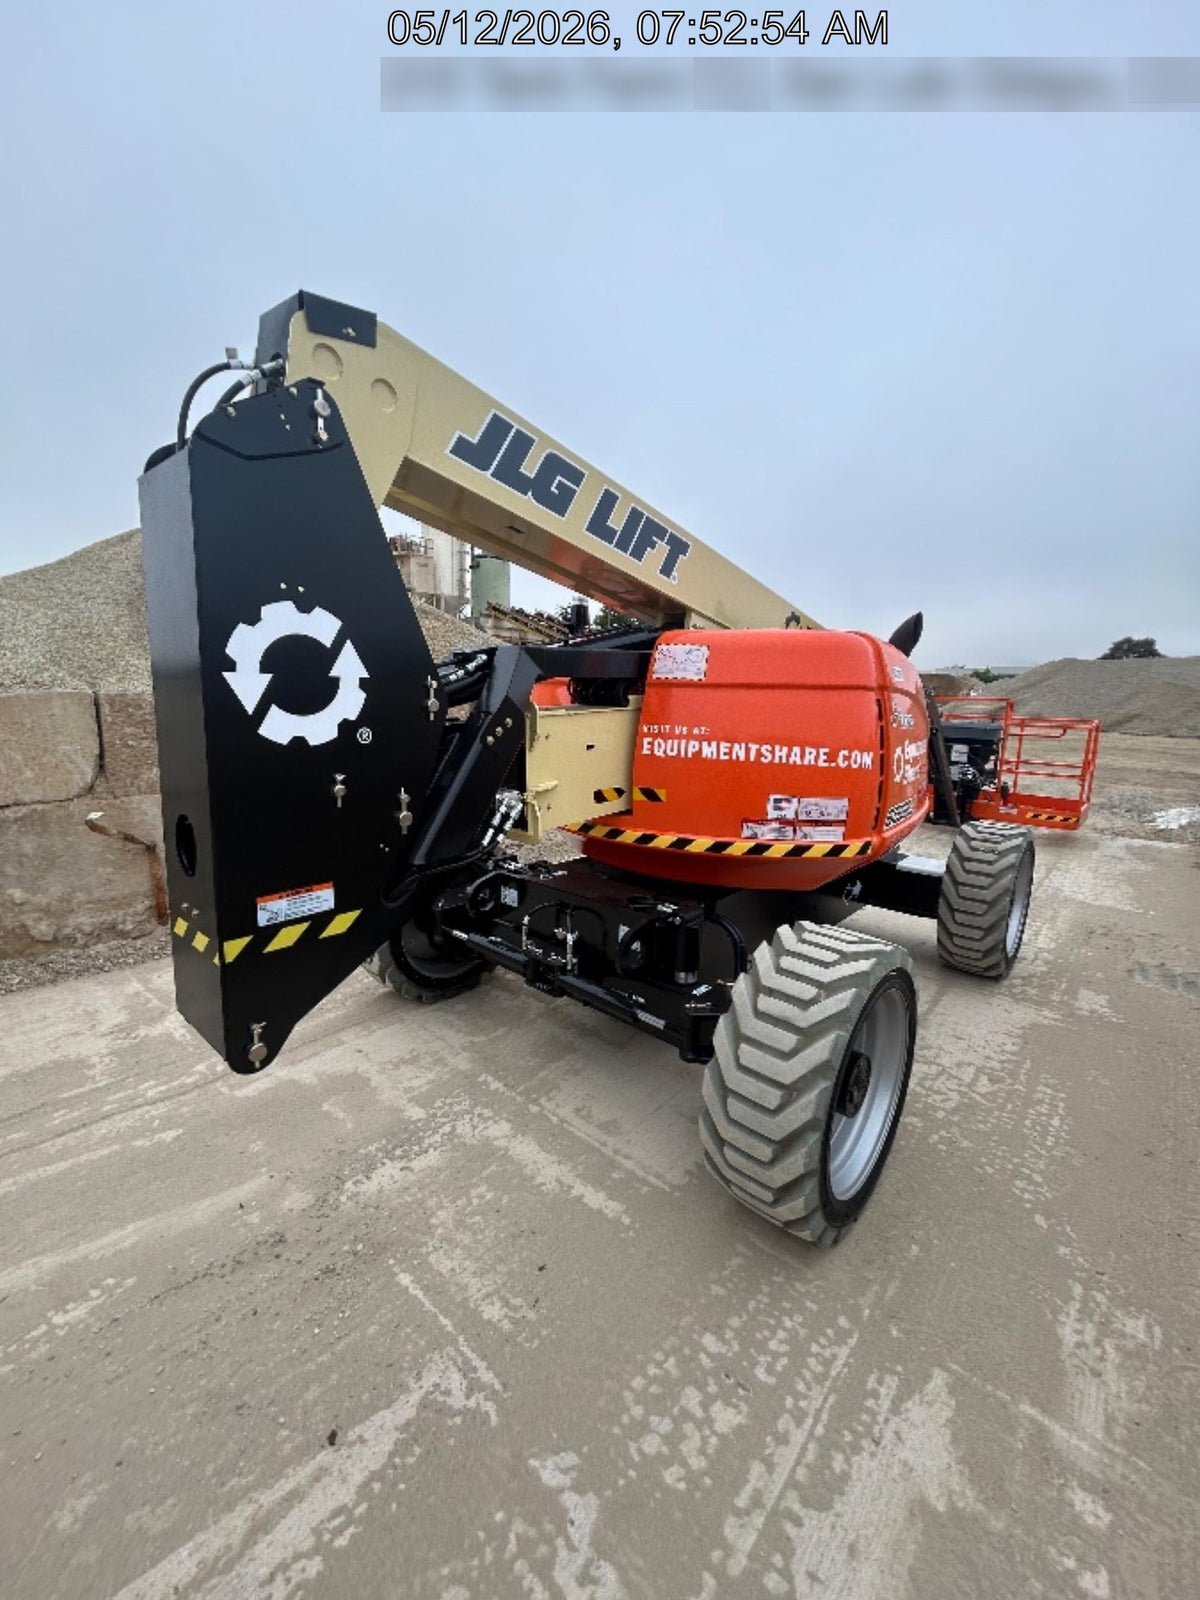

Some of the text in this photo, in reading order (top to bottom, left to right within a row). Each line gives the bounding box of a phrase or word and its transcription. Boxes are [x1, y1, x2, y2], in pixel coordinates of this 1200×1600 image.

[445, 409, 691, 583] JLG LIFT
[642, 724, 671, 733] VISIT
[674, 724, 688, 735] US
[642, 737, 874, 770] EQUIPMENTSHARE.COM
